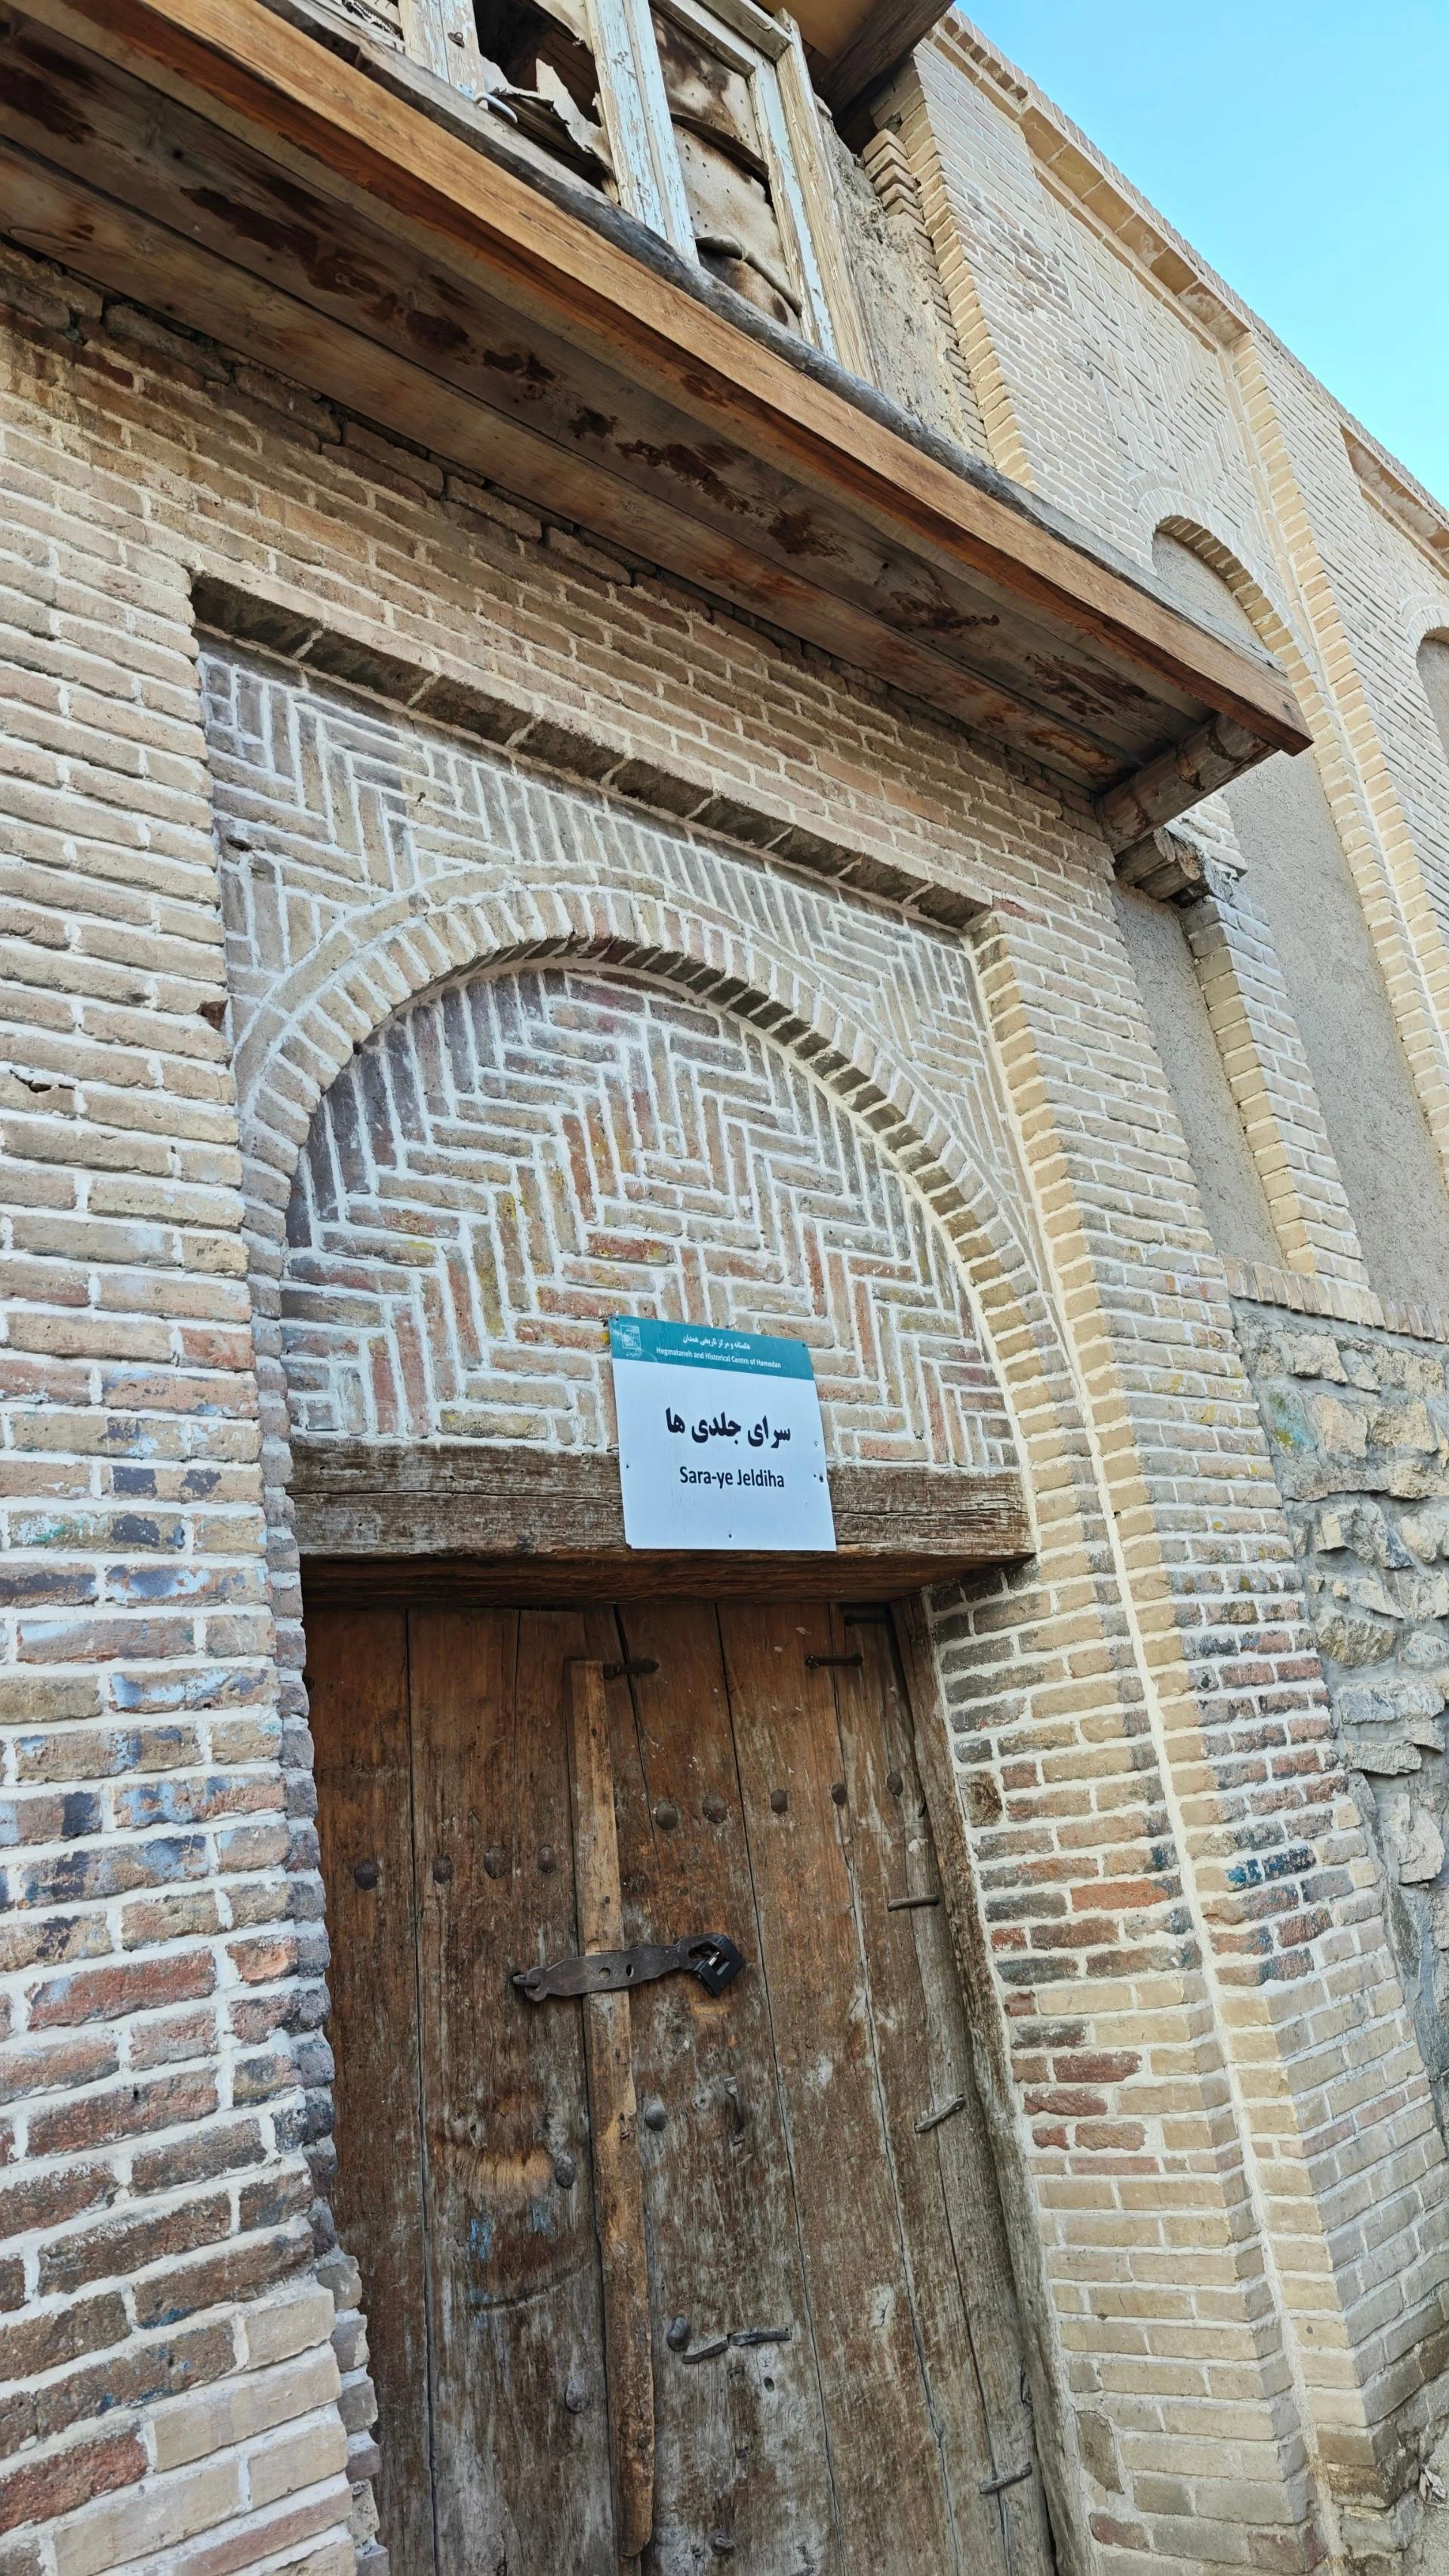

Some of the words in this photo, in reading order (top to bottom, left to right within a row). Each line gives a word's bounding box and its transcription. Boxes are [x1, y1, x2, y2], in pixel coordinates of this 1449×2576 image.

[682, 1334, 699, 1343] همدان
[700, 1336, 718, 1346] تاریخی
[718, 1339, 730, 1349] مرکز
[656, 1346, 693, 1357] Hegmataneh
[705, 1352, 731, 1362] Historical
[731, 1356, 749, 1365] Centre
[756, 1359, 782, 1368] Hamedan
[666, 1407, 685, 1433] ها
[691, 1411, 741, 1445] جلدی
[747, 1415, 791, 1448] سرای
[679, 1466, 734, 1489] Sara-ye
[737, 1469, 785, 1488] Jeldiha
